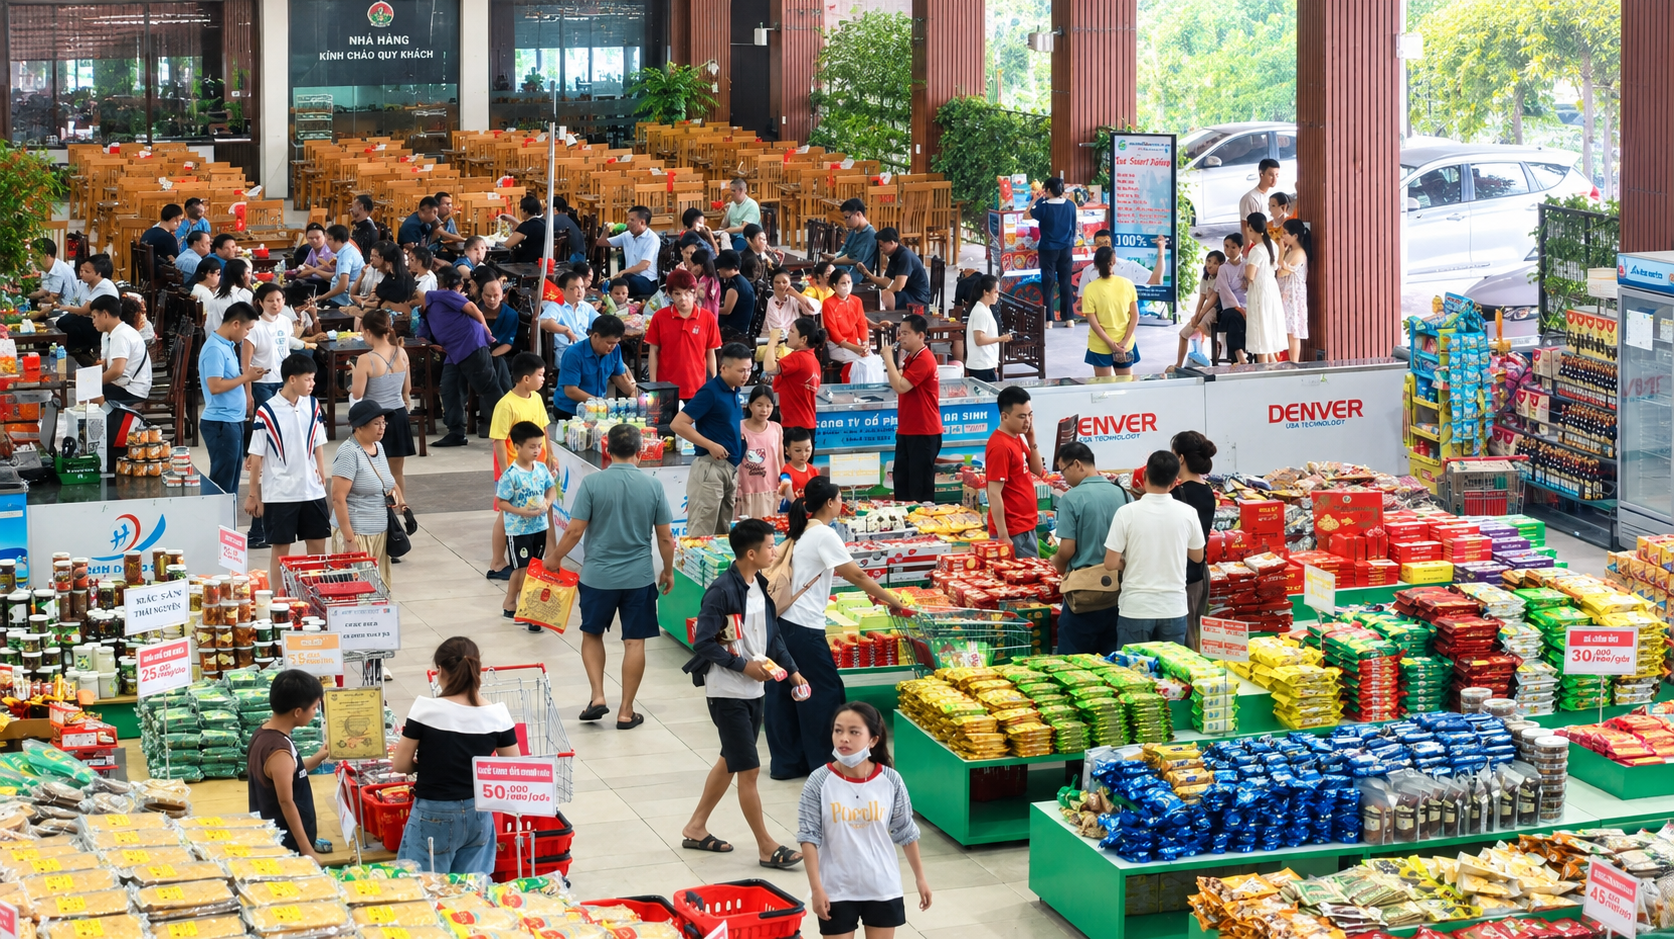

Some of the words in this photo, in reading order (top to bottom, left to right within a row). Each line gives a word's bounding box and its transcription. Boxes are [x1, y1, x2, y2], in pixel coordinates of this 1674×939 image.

[400, 48, 433, 59] KHÁCH
[1115, 235, 1147, 246] 100%
[1268, 399, 1364, 423] DENVER
[1078, 413, 1158, 436] ENVER
[1572, 649, 1592, 662] 30
[142, 667, 157, 682] 25
[483, 784, 506, 800] 50
